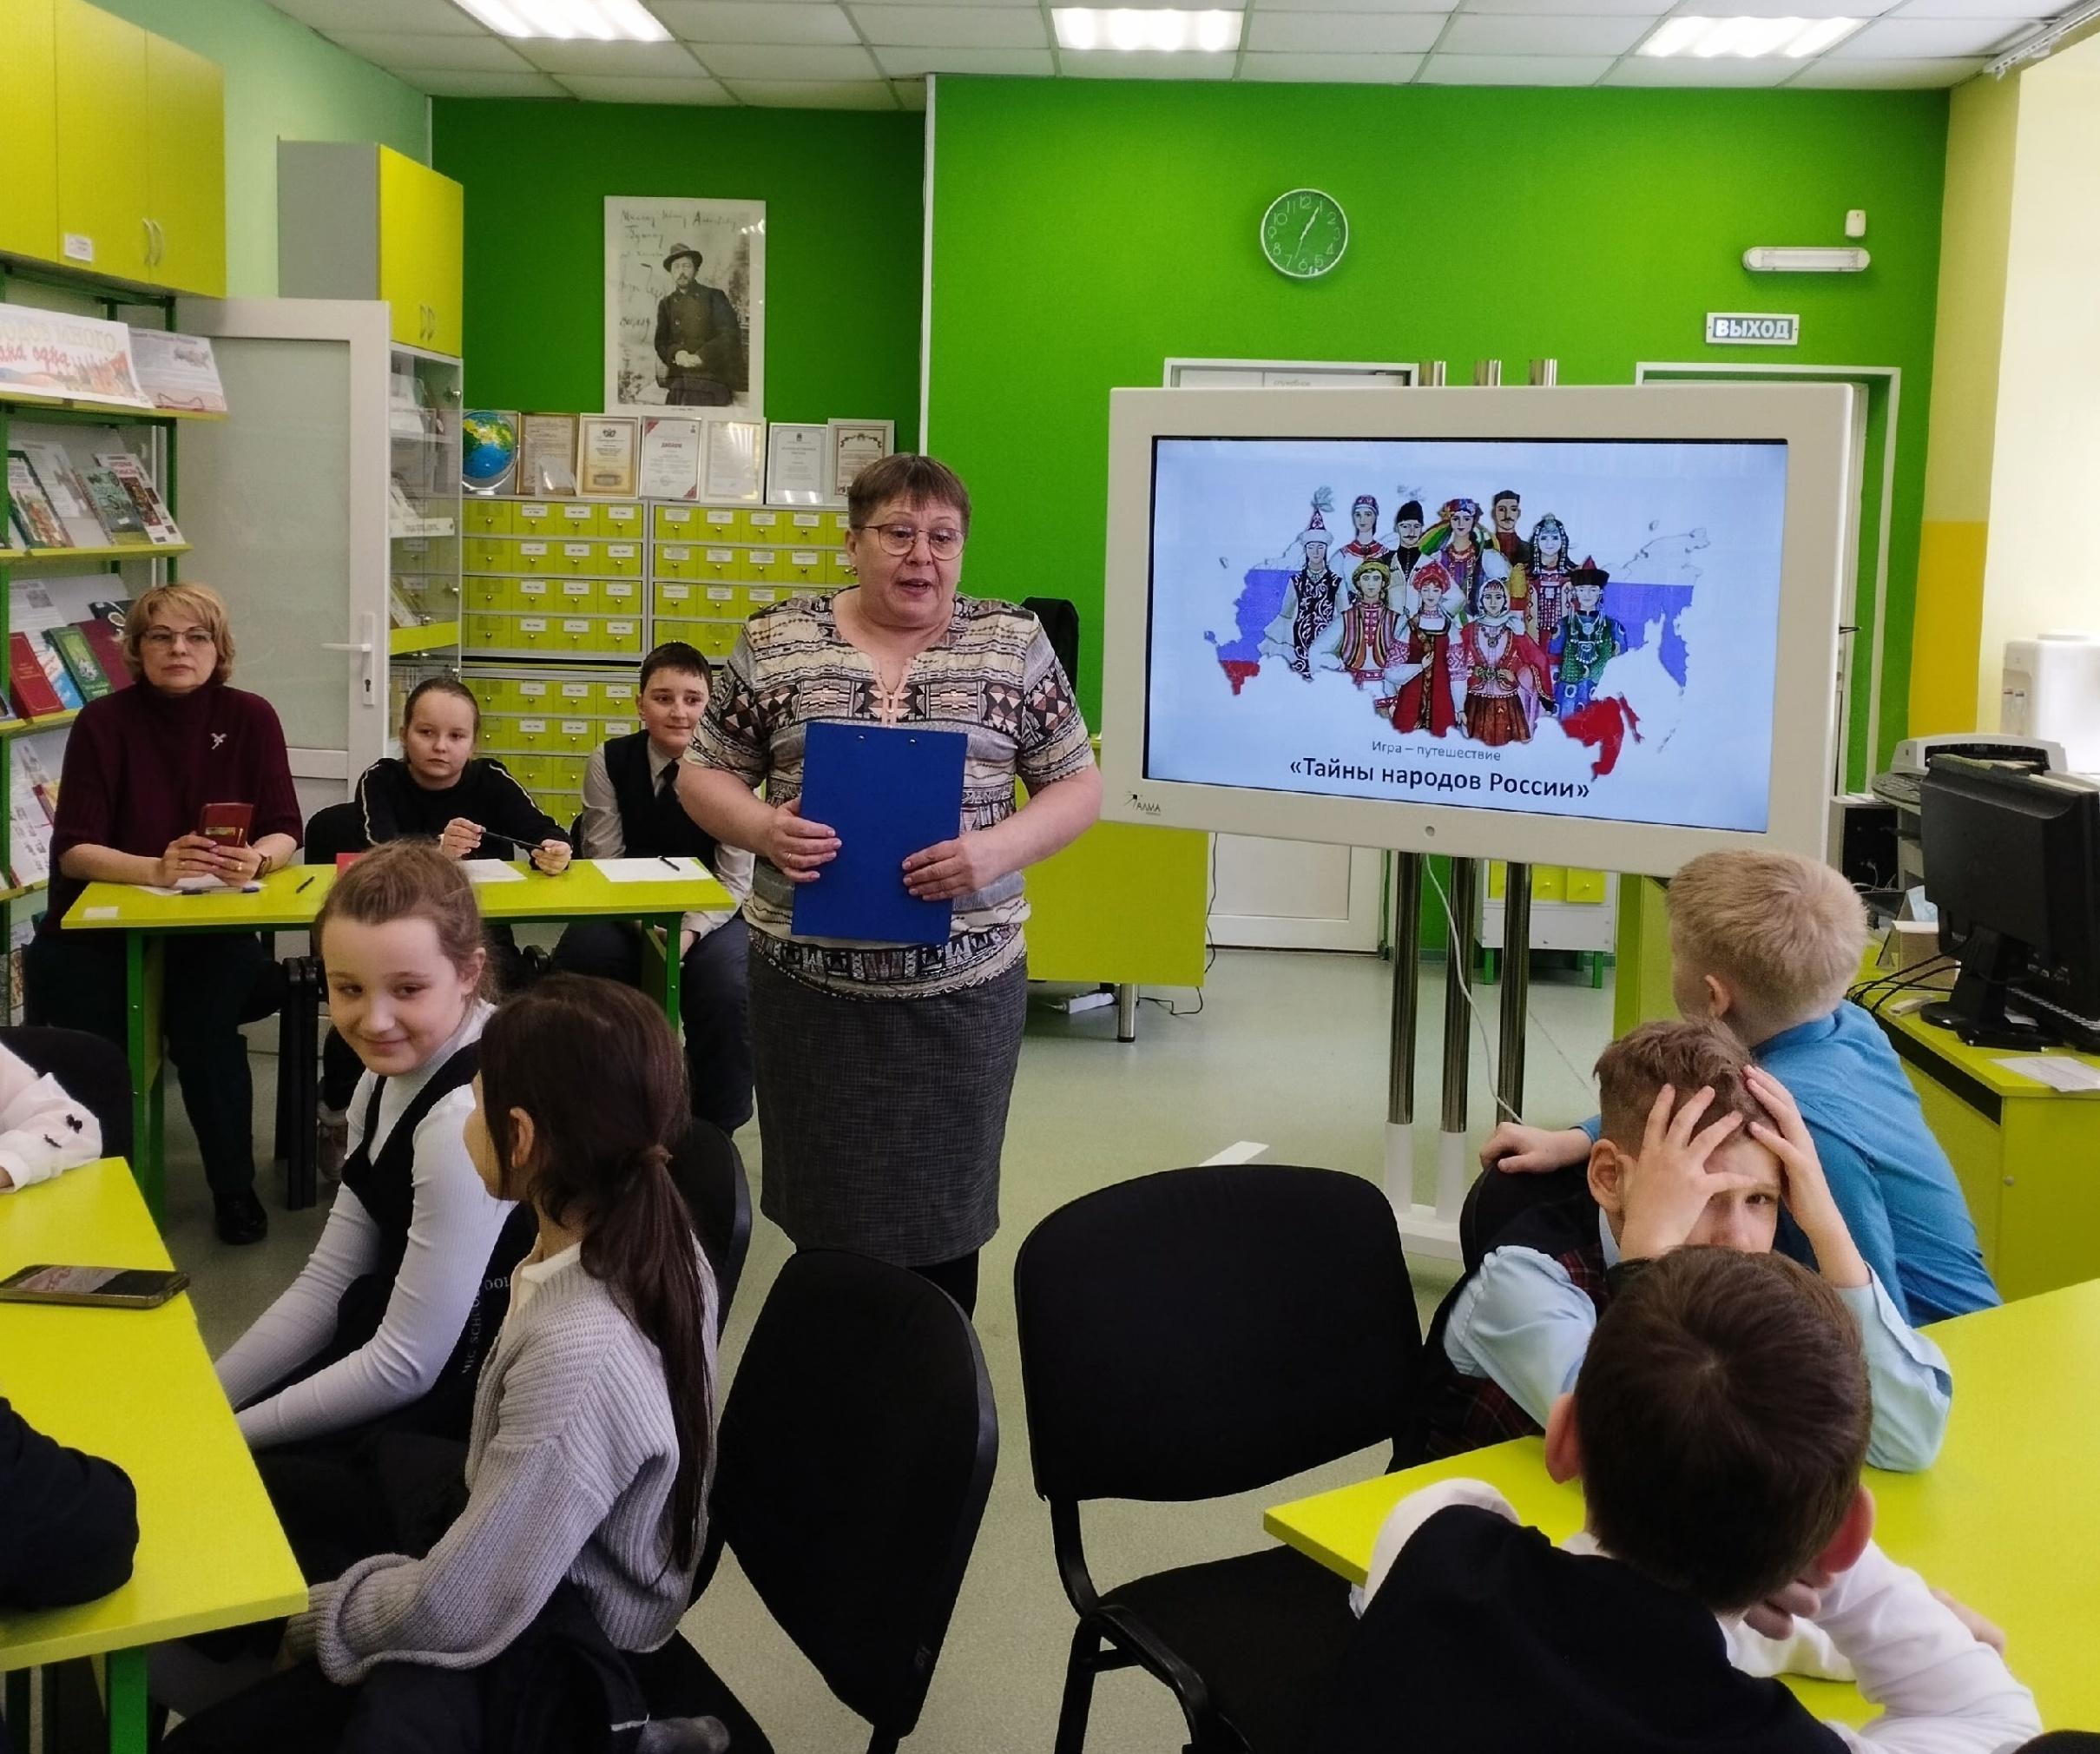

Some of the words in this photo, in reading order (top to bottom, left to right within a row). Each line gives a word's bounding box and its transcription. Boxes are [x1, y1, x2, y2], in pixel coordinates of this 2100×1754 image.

[1287, 201, 1296, 214] 11
[1300, 195, 1312, 209] 12
[1274, 213, 1287, 226] 10
[1327, 212, 1336, 225] 2
[1267, 226, 1277, 239] 9
[1333, 227, 1341, 241] 3
[1273, 242, 1281, 255] 8
[1326, 243, 1334, 254] 4
[1285, 254, 1293, 268] 7
[1298, 258, 1307, 271] 6
[1314, 254, 1324, 267] 5
[1715, 319, 1791, 340] ВЫХОД
[1372, 741, 1402, 755] Игра
[1417, 745, 1501, 762] путешествие
[1290, 757, 1374, 781] «Тайны
[1382, 768, 1481, 793] народов
[1490, 772, 1590, 798] России»
